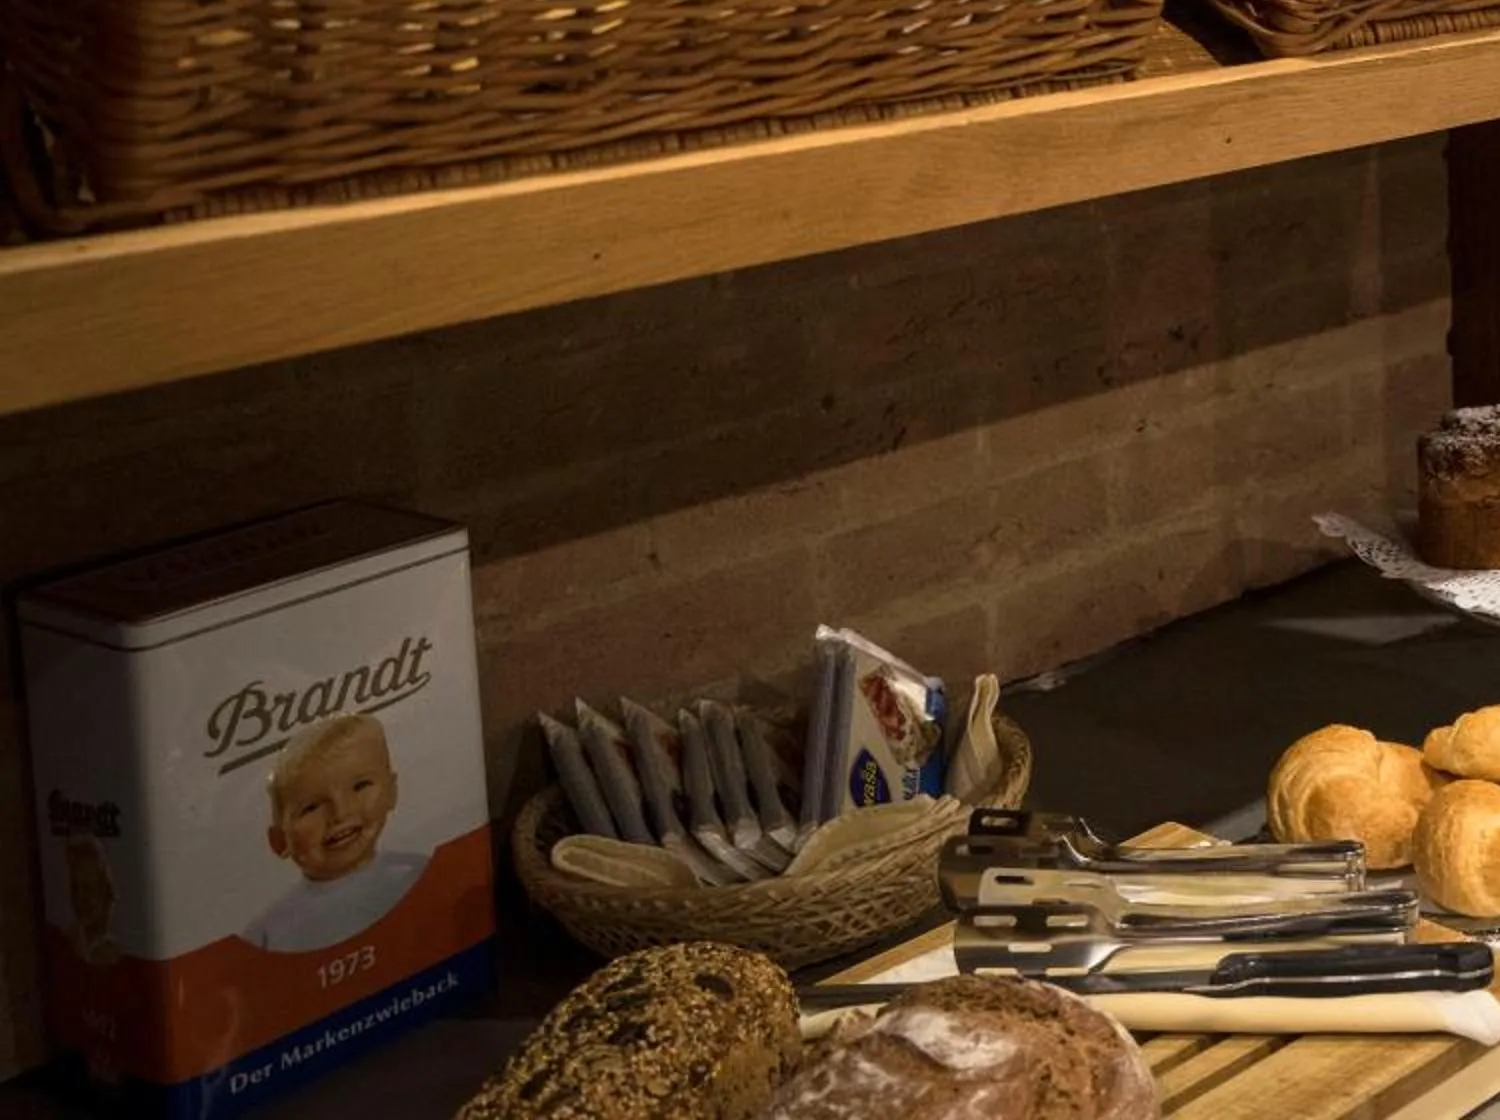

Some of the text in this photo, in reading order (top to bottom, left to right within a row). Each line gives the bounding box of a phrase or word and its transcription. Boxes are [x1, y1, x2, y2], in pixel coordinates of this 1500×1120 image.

[203, 637, 432, 762] Brandt
[316, 944, 377, 990] 1973
[229, 969, 460, 1094] Der Markenzwieback
